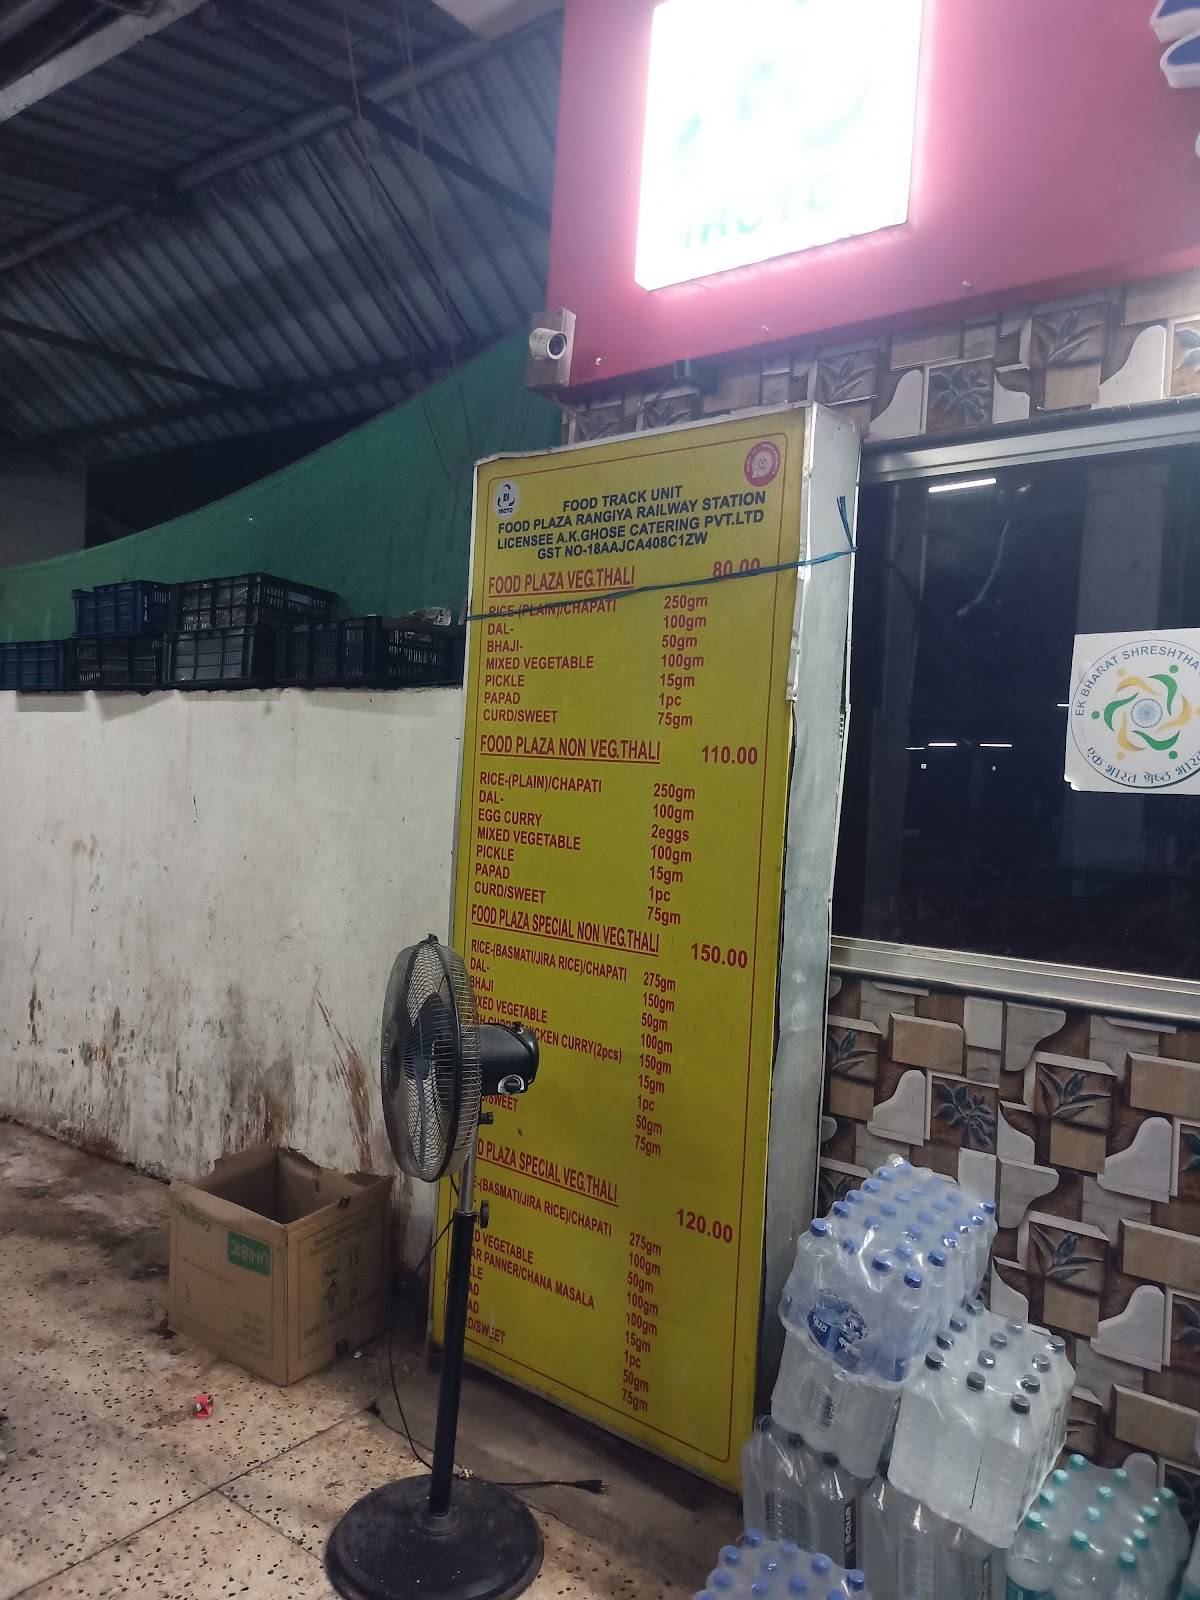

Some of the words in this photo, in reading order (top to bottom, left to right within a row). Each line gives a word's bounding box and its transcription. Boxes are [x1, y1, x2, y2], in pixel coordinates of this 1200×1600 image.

[563, 497, 598, 512] FOOD
[602, 490, 647, 507] TRACK
[651, 485, 683, 501] UNIT
[498, 520, 530, 534] FOOD
[533, 516, 572, 531] PLAZA
[576, 508, 633, 526] RANGIYA
[636, 499, 699, 519] RAILWAY
[702, 491, 766, 511] STATION
[497, 533, 553, 550] LICENSEE
[556, 525, 626, 544] A.K.GHOSE
[629, 517, 700, 537] CATERING
[704, 509, 765, 529] PVT.LTD
[537, 546, 561, 560] GST
[712, 557, 761, 577] 8000
[488, 575, 521, 594] FOOD
[524, 572, 564, 592] PLAZA
[567, 565, 635, 589] VEG.THALI
[664, 594, 708, 610] 250gm
[487, 623, 514, 636] DAL-
[663, 615, 707, 631] 100gm
[486, 640, 523, 653] BHAJI-
[661, 635, 698, 650] 50gm
[485, 657, 520, 670] MIXED
[523, 656, 594, 669] VEGETABLE
[661, 654, 705, 670] 100gm
[485, 674, 525, 687] PICKLE
[659, 674, 695, 690] 15gm
[1075, 701, 1085, 716] EK
[1080, 655, 1118, 697] BHARAT
[1122, 645, 1200, 671] SHRESHTHA
[484, 692, 521, 705] PAPAD
[658, 694, 682, 709] 1pc
[483, 709, 558, 723] CURD/SWEET
[657, 712, 693, 729] 75gm
[480, 735, 512, 753] FOOD
[516, 736, 554, 755] PLAZA
[559, 738, 586, 756] NON
[590, 739, 660, 761] VEG.THALI
[701, 745, 758, 765] 110.00
[480, 772, 602, 793] RICE-(PLAIN)/CHAPATI
[1105, 764, 1137, 783] भारत
[479, 790, 504, 805] DAL-
[653, 783, 696, 801] 250gm
[478, 808, 501, 823] EGG
[504, 810, 542, 826] CURRY
[652, 804, 695, 823] 100gm
[477, 827, 510, 842] MIXED
[513, 830, 581, 850] VEGETABLE
[651, 824, 689, 844] 2eggs
[476, 845, 514, 862] PICKLE
[650, 845, 692, 864] 100gm
[475, 863, 510, 880] PAPAD
[649, 866, 684, 884] 15gm
[474, 881, 546, 904] CURD/SWEET
[648, 886, 671, 903] 1pc
[647, 905, 681, 926] 75gm
[471, 904, 497, 924] FOOD
[499, 908, 530, 930] PLAZA
[532, 915, 574, 939] SPECIAL
[577, 922, 600, 942] NON
[603, 925, 660, 953] VEG.THALI
[470, 957, 490, 973] DAL-
[691, 942, 748, 969] 150.00
[558, 957, 627, 982] RICE)/CHAPATI
[470, 976, 494, 992] BHAJI
[643, 971, 676, 992] 275gm
[473, 995, 494, 1011] IXED
[496, 999, 548, 1024] VEGETABLE
[642, 993, 675, 1012] 150gm
[641, 1013, 668, 1032] 50gm
[561, 1034, 622, 1065] CURRY(2pcs)
[640, 1032, 673, 1053] 100gm
[639, 1054, 672, 1074] 150gm
[638, 1074, 665, 1094] 15gm
[637, 1094, 655, 1112] 1pc
[635, 1114, 662, 1135] 50gm
[634, 1135, 661, 1156] 75gm
[486, 1140, 517, 1169] PLAZA
[519, 1152, 561, 1183] SPECIAL
[563, 1167, 618, 1203] VEG.THALI
[544, 1201, 612, 1238] RICE)/CHAPATI
[677, 1208, 733, 1244] 120.00
[483, 1232, 534, 1265] VEGETABLE
[629, 1232, 662, 1257] 275gm
[628, 1251, 661, 1276] 100gm
[484, 1251, 553, 1292] PANNER/CHANA
[555, 1281, 595, 1310] MASALA
[627, 1271, 654, 1294] 50gm
[626, 1292, 659, 1316] 100gm
[625, 1312, 658, 1337] 100gm
[625, 1331, 651, 1353] 15gm
[623, 1350, 641, 1370] 1pc
[622, 1369, 649, 1393] 50gm
[621, 1388, 648, 1412] 75gm
